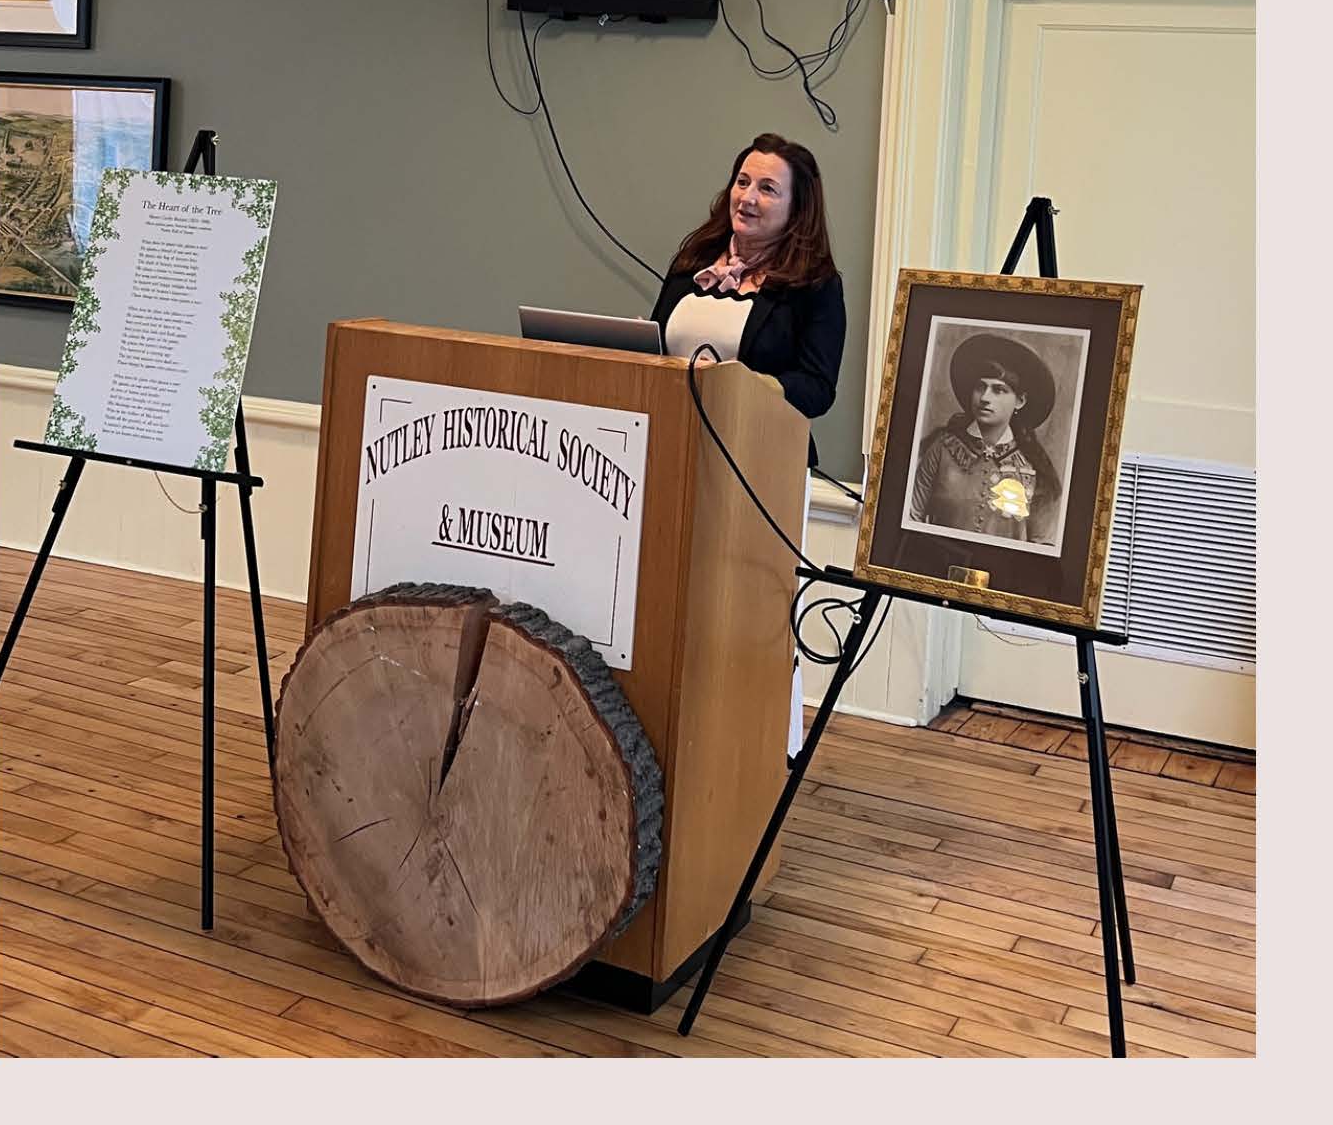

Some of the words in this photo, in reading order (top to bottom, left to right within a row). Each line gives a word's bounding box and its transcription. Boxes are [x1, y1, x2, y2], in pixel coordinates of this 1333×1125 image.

[142, 200, 156, 209] The
[158, 201, 180, 212] Heart
[181, 203, 190, 213] of
[192, 205, 204, 214] the
[206, 206, 223, 216] Tree
[365, 413, 437, 485] NUTLEY
[442, 406, 551, 463] HISTORICAL
[557, 427, 637, 521] SOCIETY
[438, 503, 453, 542] &
[457, 506, 550, 560] MUSEUM
